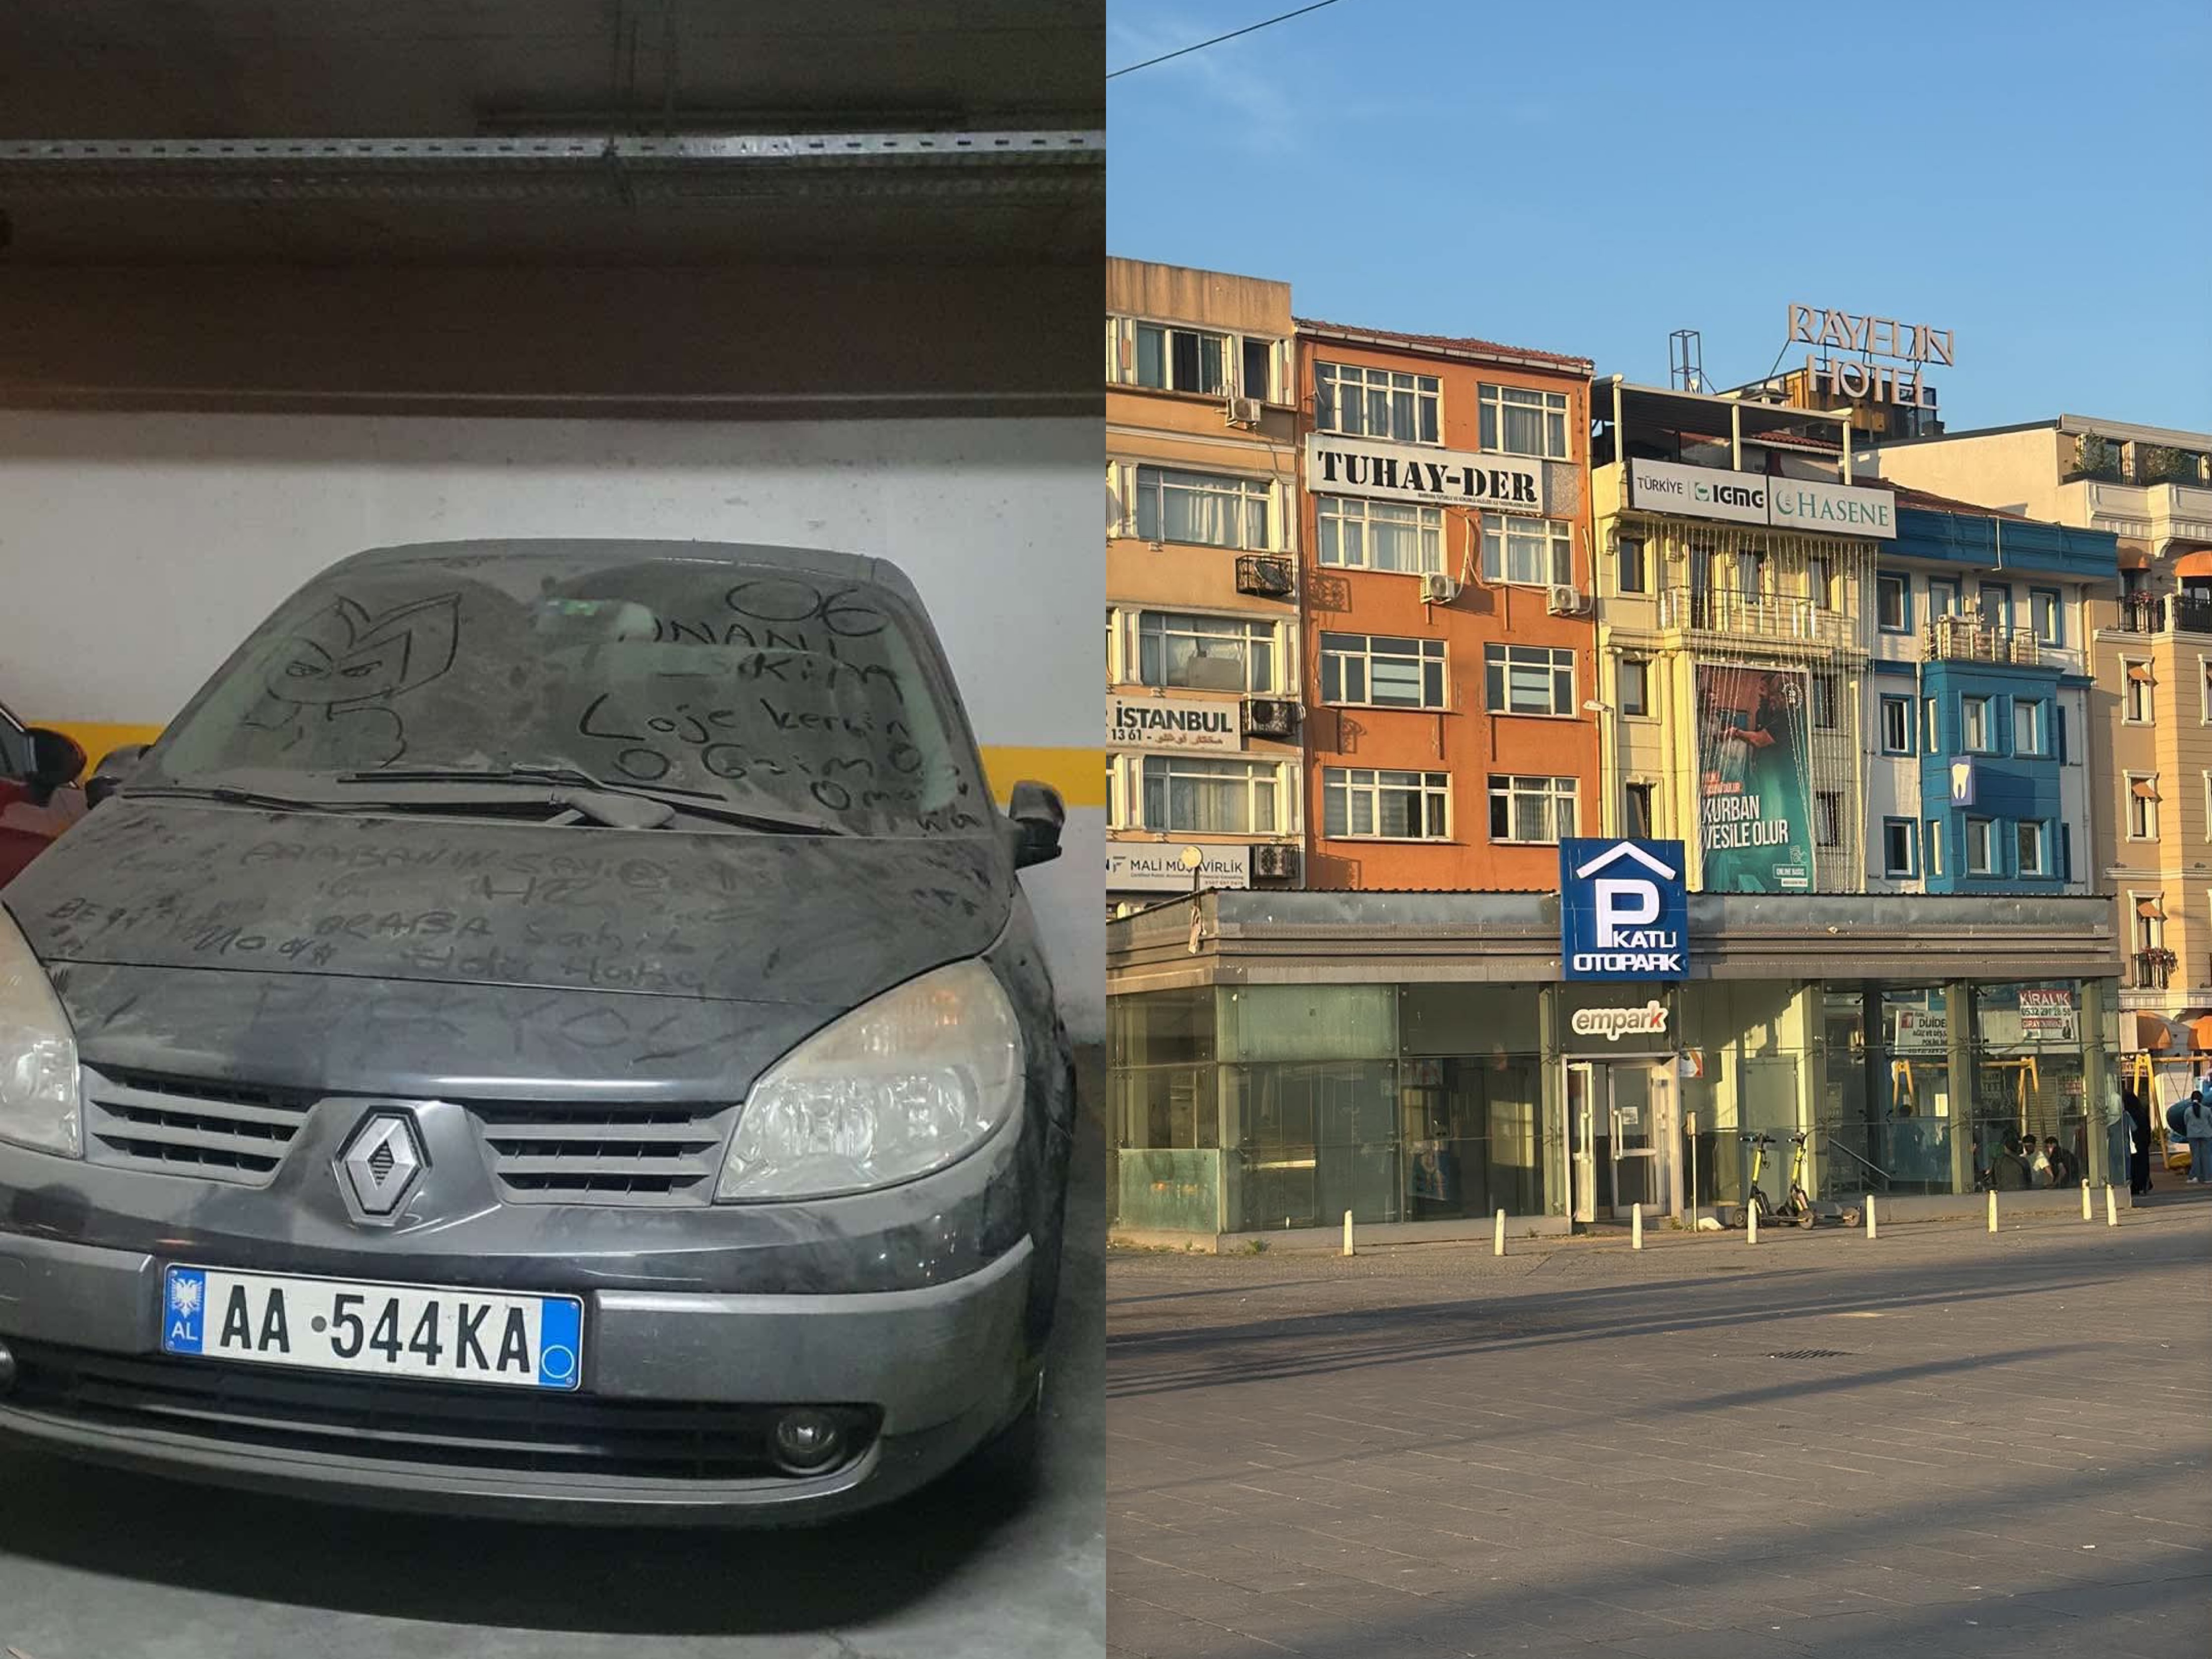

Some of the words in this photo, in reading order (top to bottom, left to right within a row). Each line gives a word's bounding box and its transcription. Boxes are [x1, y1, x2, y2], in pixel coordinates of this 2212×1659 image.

[1807, 354, 1940, 410] HOTEL
[1317, 450, 1537, 502] TUHAY-DER
[1637, 476, 1683, 494] TÜRKİYE
[1799, 491, 1889, 526] HASENE
[1116, 700, 1233, 733] İSTANBUL
[1111, 728, 1142, 741] 1361
[1702, 795, 1760, 824] KURBAN
[1752, 818, 1789, 846] OLUR
[1130, 858, 1162, 871] MALİ
[1595, 879, 1659, 948] P
[1612, 931, 1677, 948] KATLI
[1573, 953, 1681, 972] OTOPARK
[2020, 990, 2070, 1005] KİRALIK
[1576, 1006, 1664, 1036] empark
[171, 1321, 198, 1341] AL
[219, 1284, 290, 1353] AA
